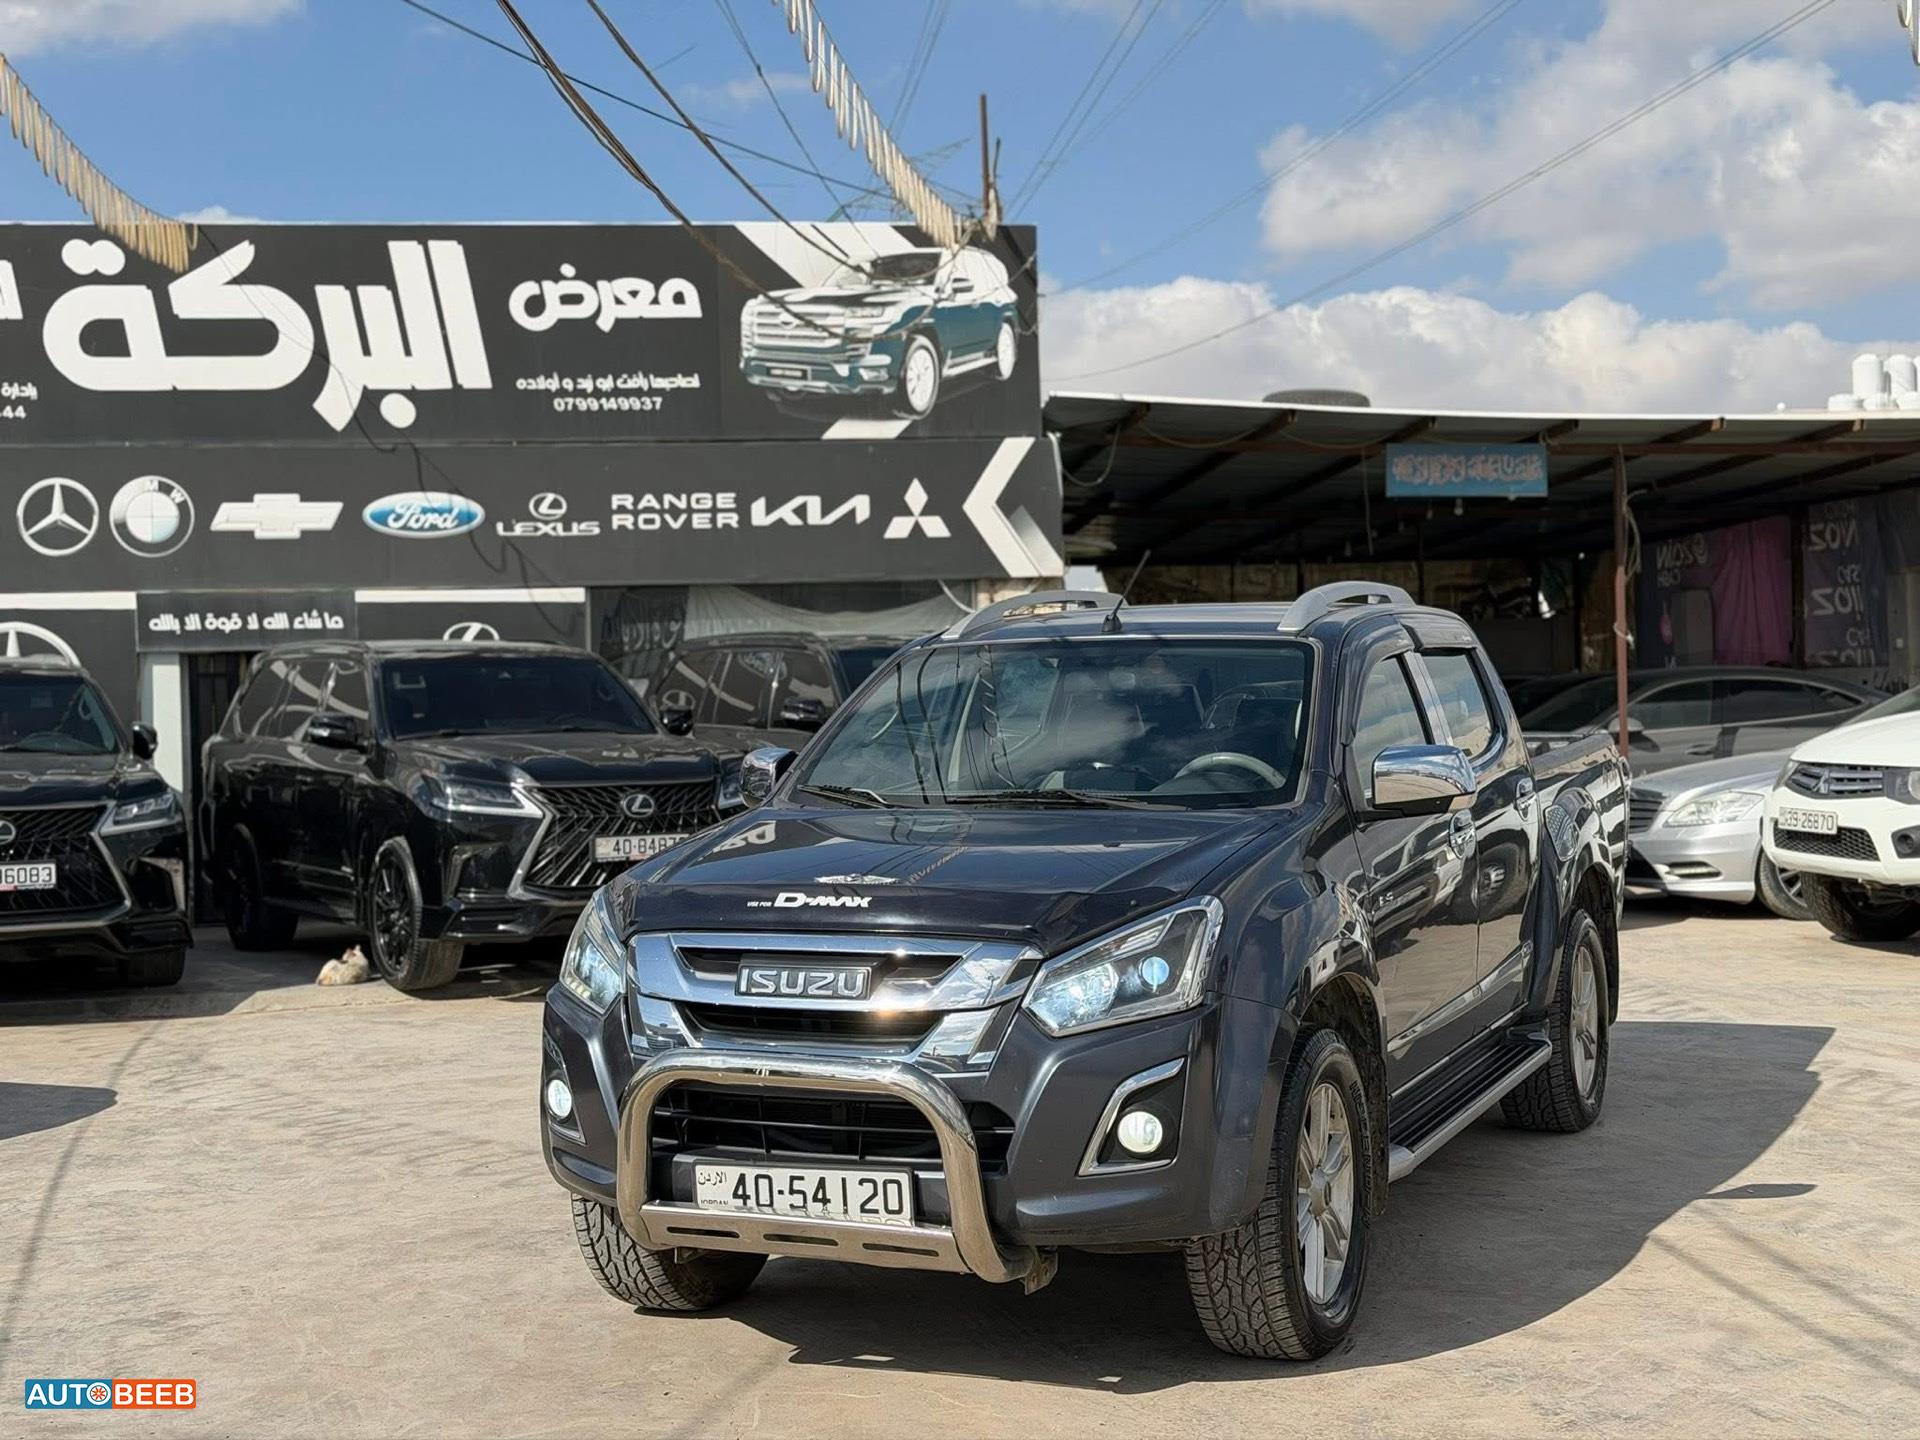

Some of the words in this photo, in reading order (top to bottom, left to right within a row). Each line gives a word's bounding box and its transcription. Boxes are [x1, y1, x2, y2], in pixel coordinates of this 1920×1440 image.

[508, 262, 703, 334] معرض
[42, 239, 493, 432] البركة
[552, 396, 663, 412] 0799149937
[611, 493, 737, 510] RANGE
[387, 501, 461, 530] Ford
[612, 513, 739, 530] ROVER
[496, 521, 601, 537] LEXUS
[148, 613, 181, 635] بالله
[204, 612, 243, 635] قوة
[247, 612, 260, 630] لا
[262, 612, 290, 630] الله
[293, 608, 323, 630] شاء
[323, 611, 345, 630] ما
[0, 866, 53, 885] 6083
[773, 892, 873, 908] D-MAX
[739, 968, 865, 998] ISUZU
[732, 1172, 903, 1216] 40-54120
